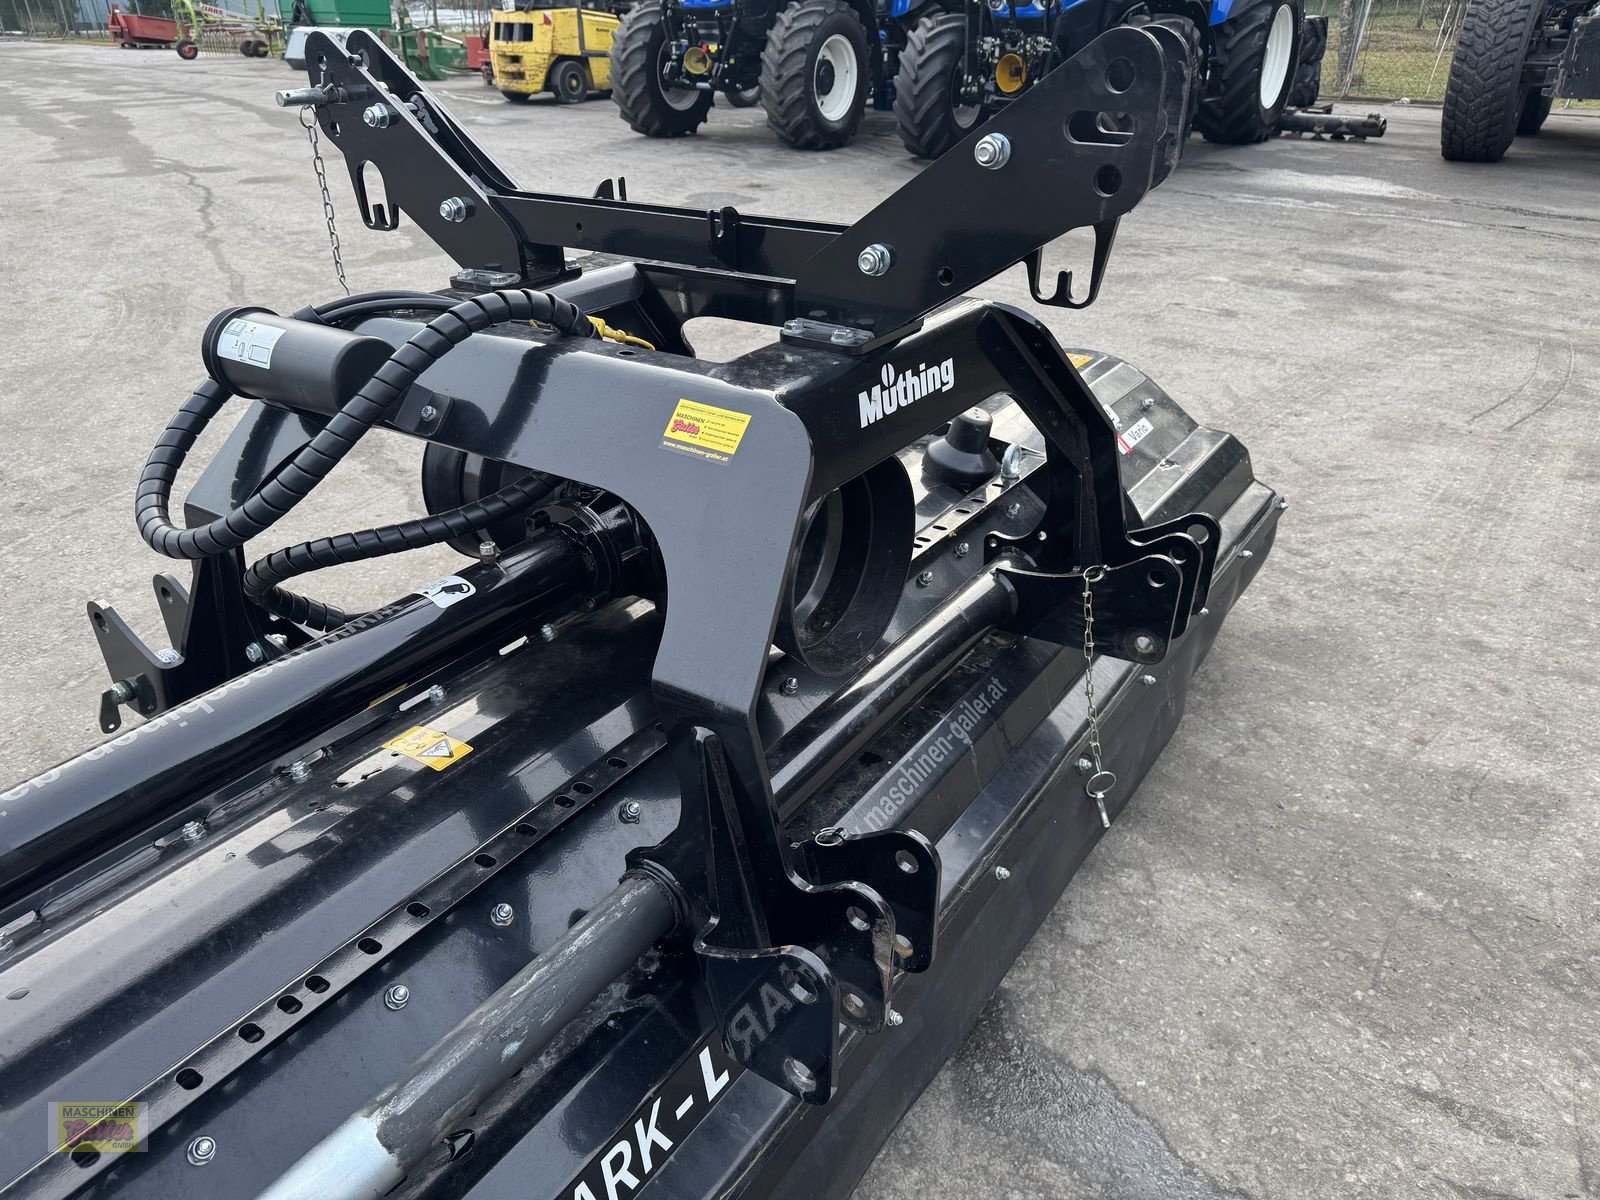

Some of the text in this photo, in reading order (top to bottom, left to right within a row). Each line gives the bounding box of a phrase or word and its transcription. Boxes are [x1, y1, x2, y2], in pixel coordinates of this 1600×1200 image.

[858, 357, 955, 429] Müthing
[675, 411, 706, 424] MASCHINEN
[1127, 423, 1149, 442] Vario
